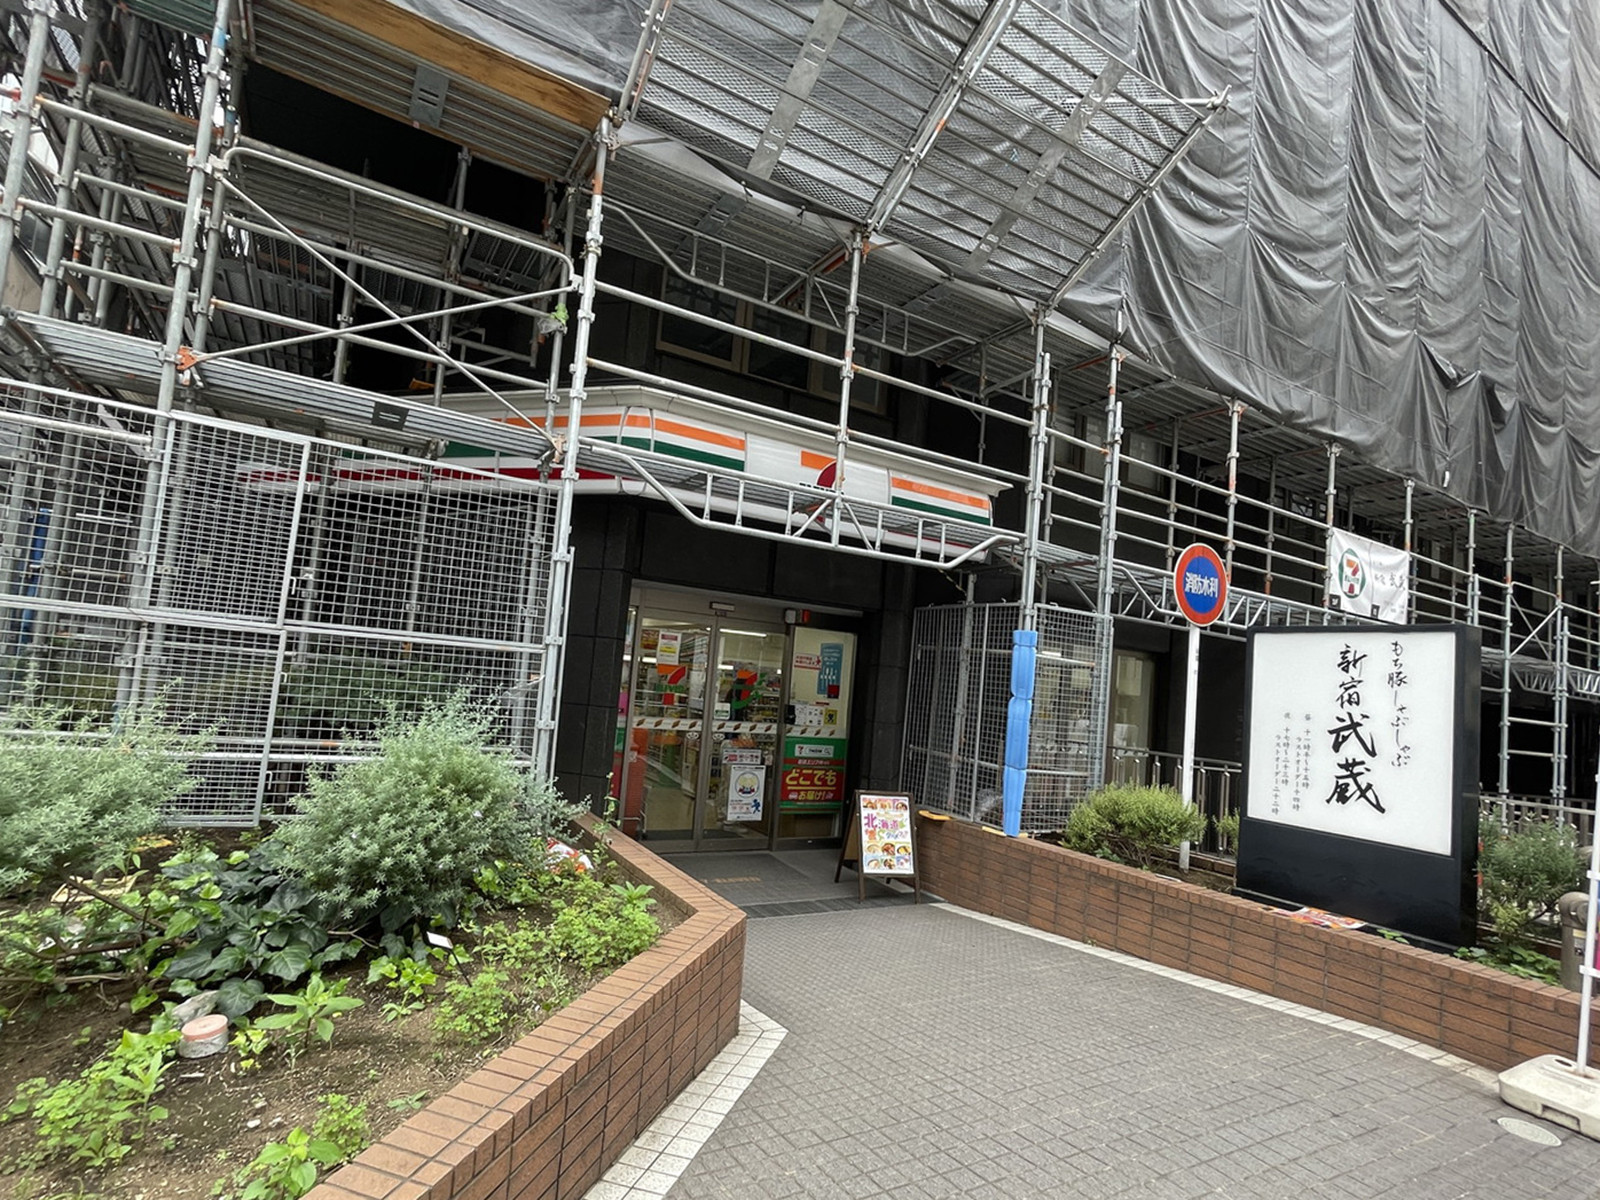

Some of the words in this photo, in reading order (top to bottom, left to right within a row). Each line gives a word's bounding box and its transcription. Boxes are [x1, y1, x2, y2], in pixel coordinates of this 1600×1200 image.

[1184, 571, 1219, 598] 消防水利
[1387, 641, 1411, 767] もち豚しゃぶしゃぶ
[1325, 643, 1386, 814] 新宿武蔵
[785, 768, 837, 785] どこでも
[863, 813, 899, 830] 北海道
